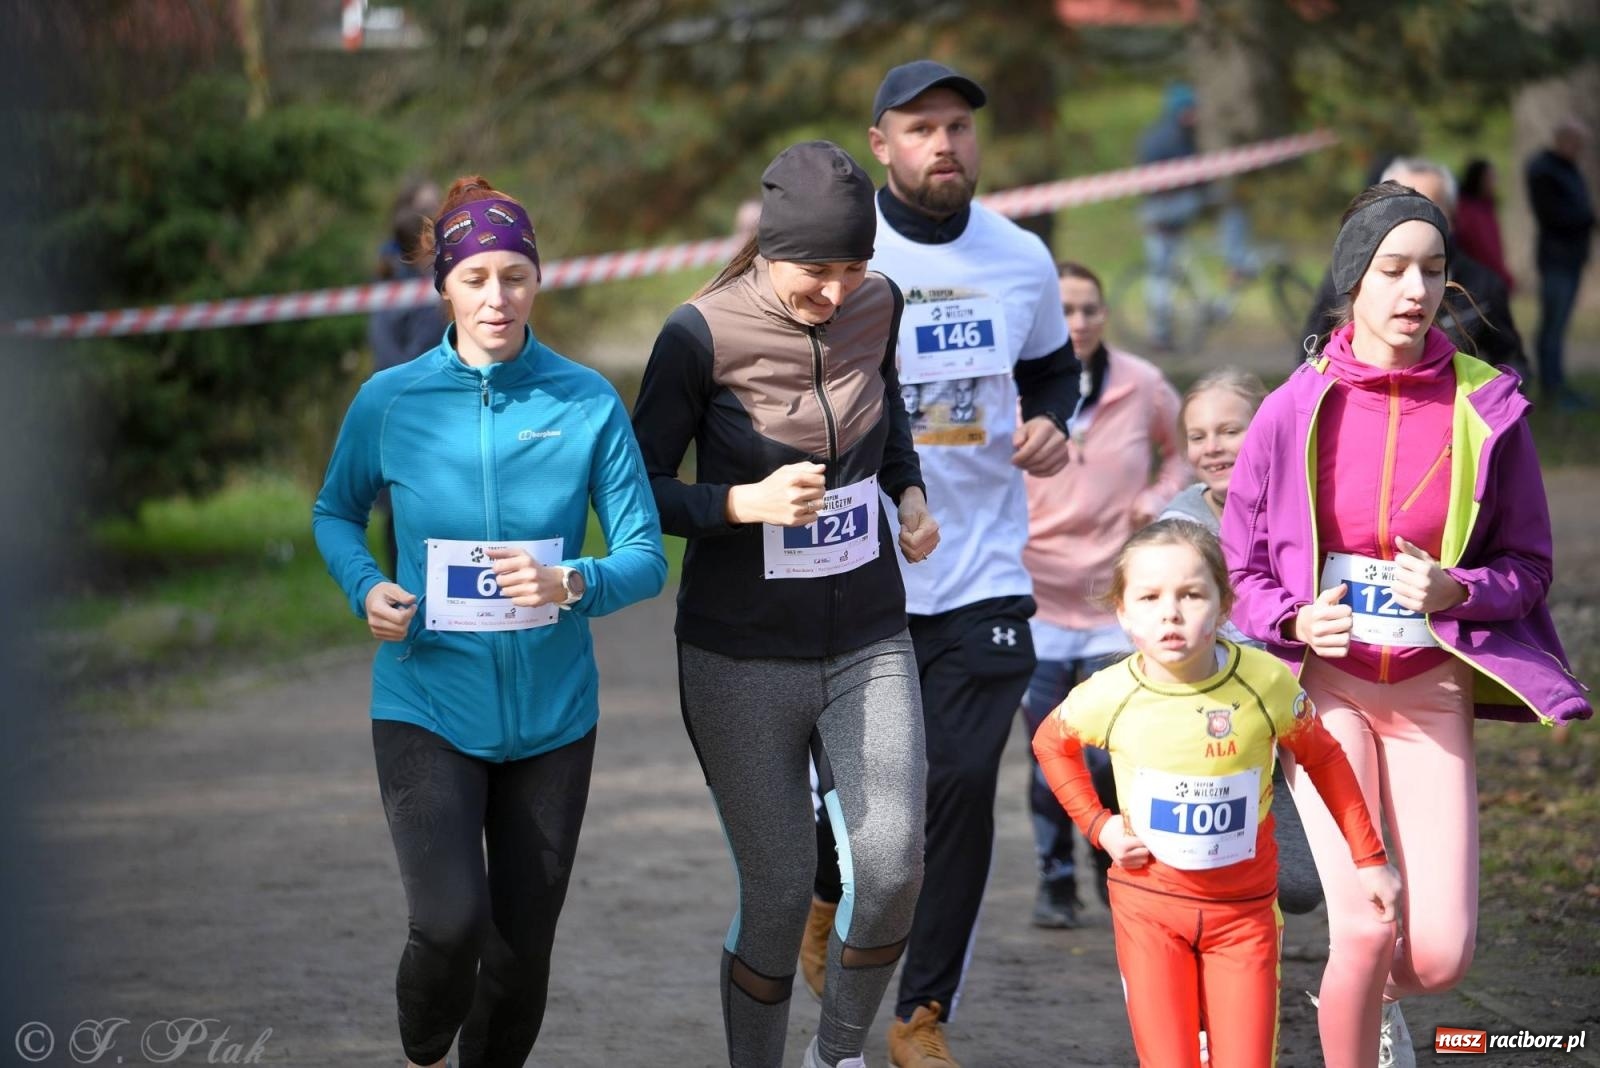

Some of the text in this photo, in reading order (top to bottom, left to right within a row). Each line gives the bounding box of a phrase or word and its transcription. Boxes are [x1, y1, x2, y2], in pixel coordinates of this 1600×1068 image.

[932, 321, 982, 350] 146
[804, 510, 857, 545] 124
[476, 569, 507, 597] 6
[1360, 585, 1416, 616] 12
[1204, 740, 1237, 758] ALA
[1194, 786, 1230, 797] WILCZYM
[1172, 802, 1232, 834] 100
